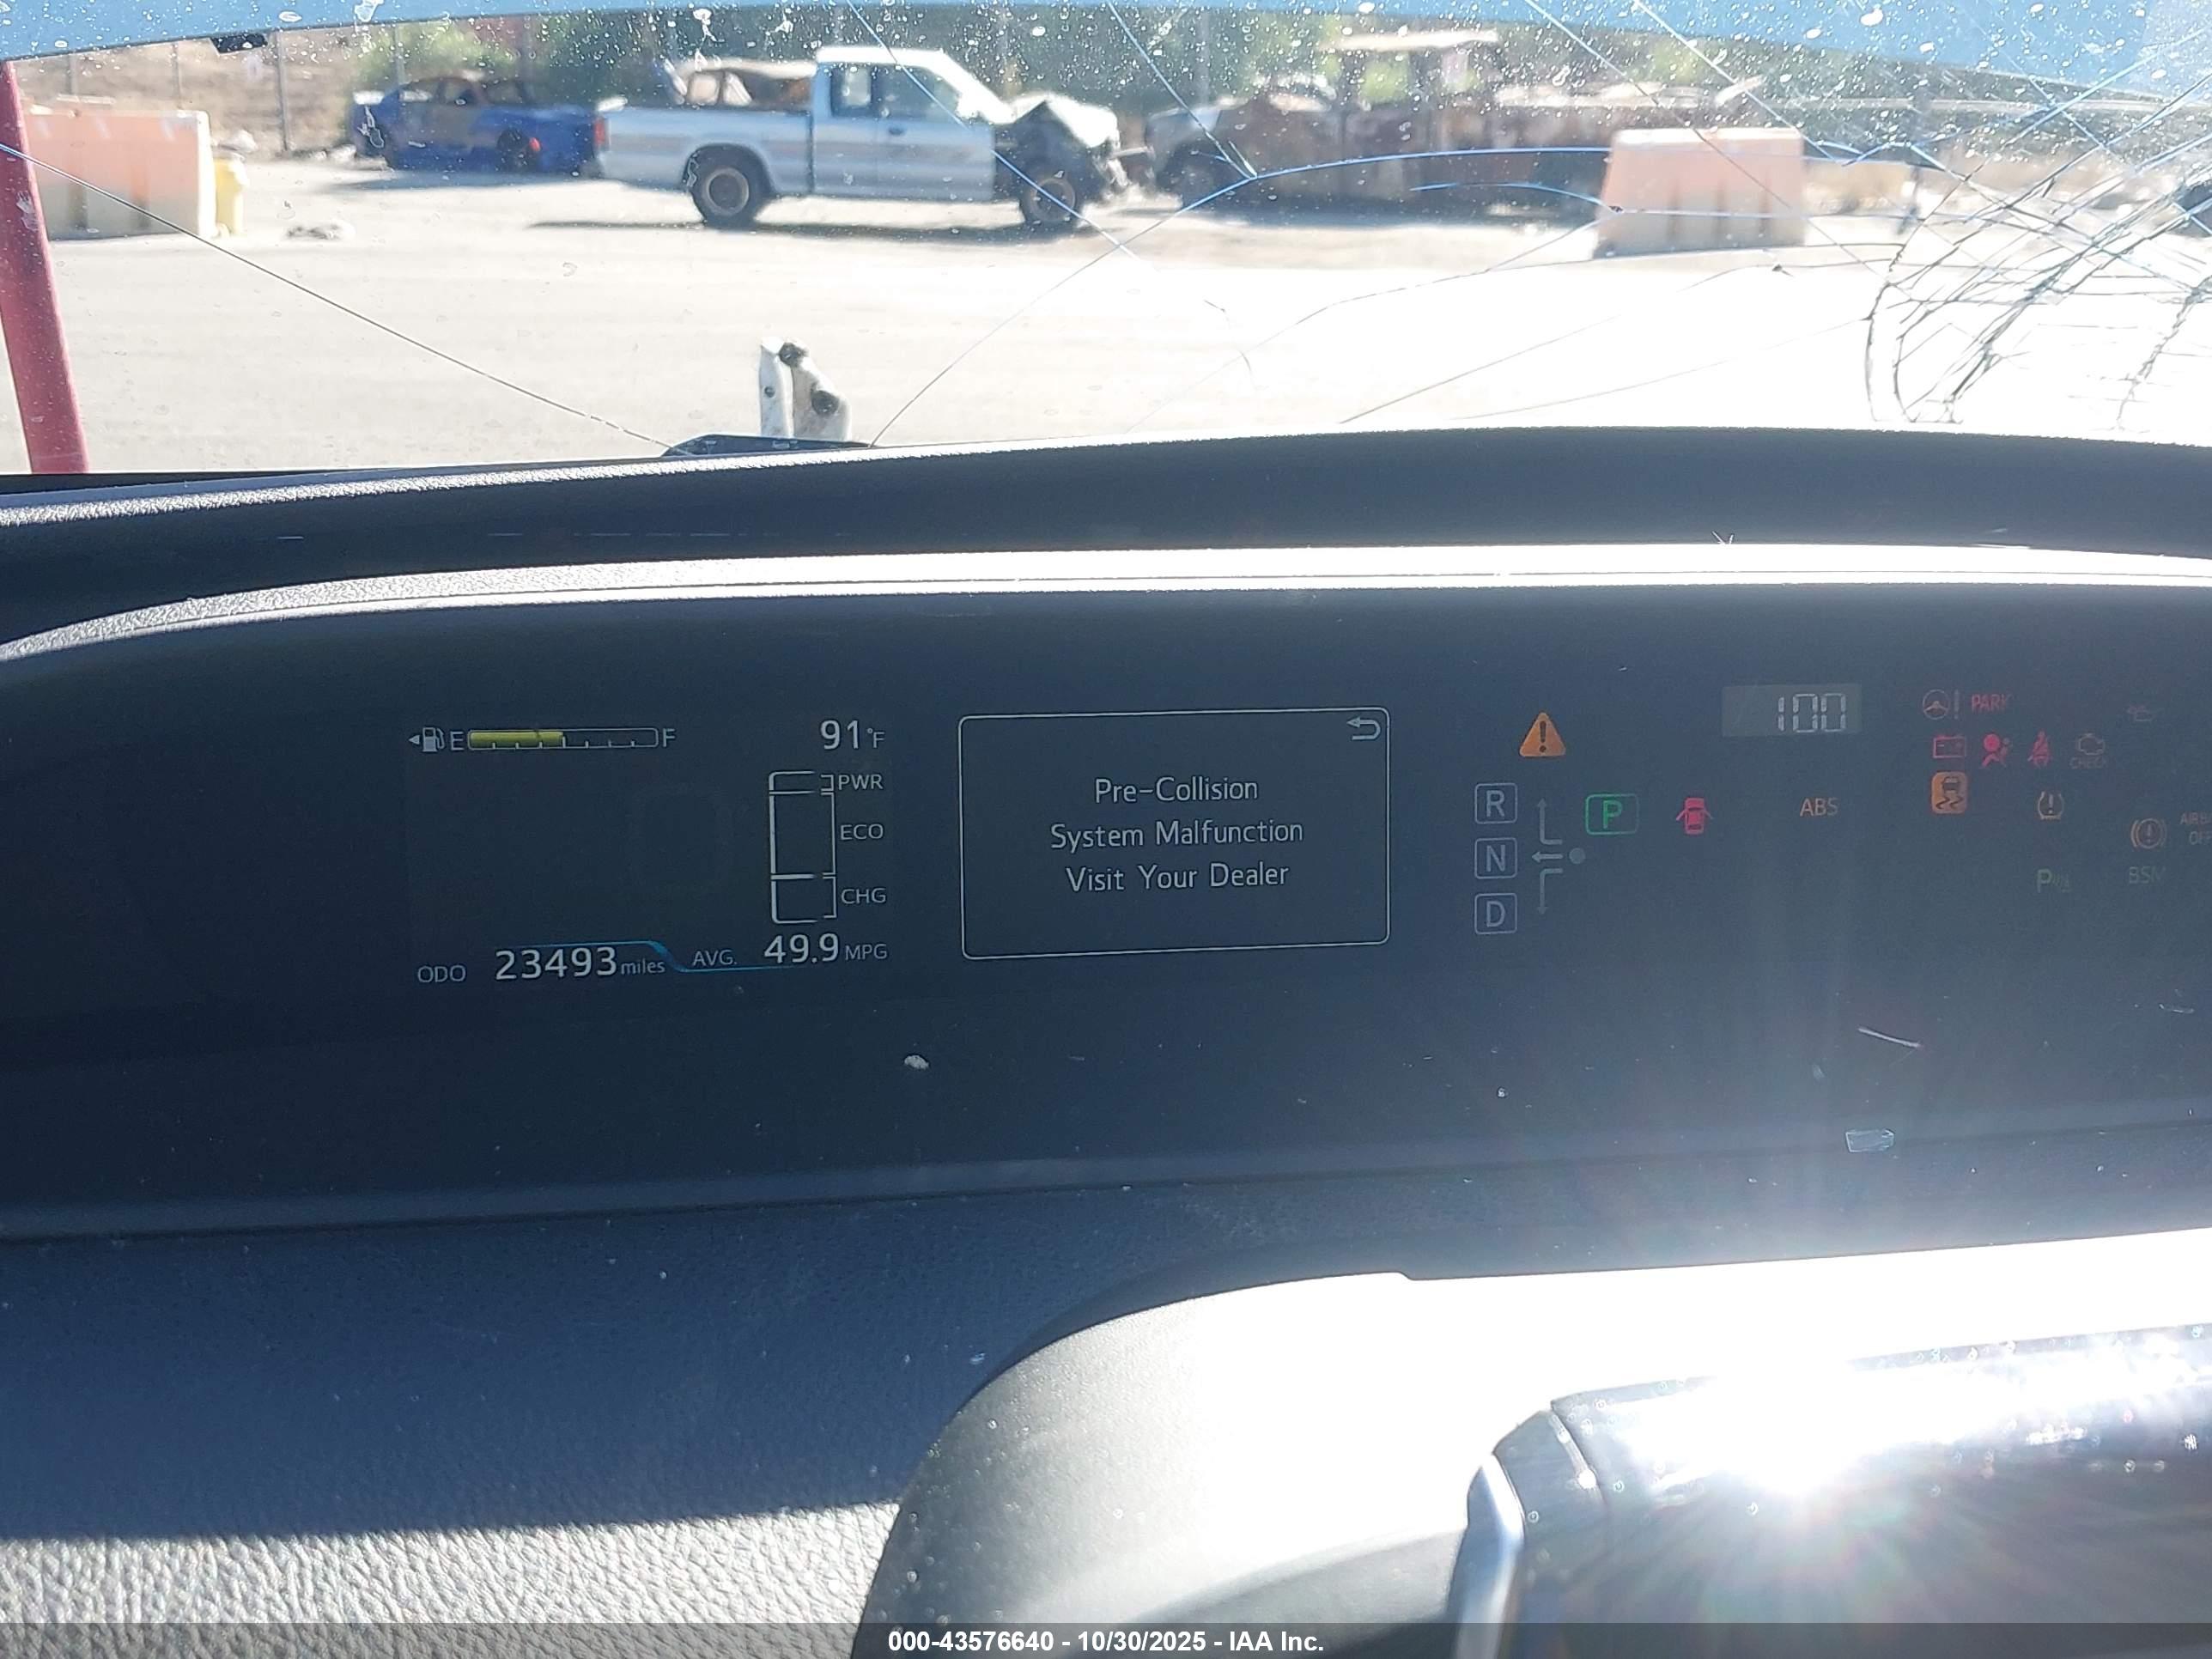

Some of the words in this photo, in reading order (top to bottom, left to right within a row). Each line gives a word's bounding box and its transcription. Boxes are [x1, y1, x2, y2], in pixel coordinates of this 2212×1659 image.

[837, 774, 884, 790] PWR
[1095, 775, 1259, 804] Pre-Collision
[1486, 790, 1505, 817] R
[1602, 799, 1623, 830] P
[1799, 798, 1839, 817] ABS
[840, 823, 884, 841] ECO
[1050, 823, 1144, 854] System
[1156, 819, 1304, 846] Malfunction
[1486, 846, 1506, 872] N
[1066, 866, 1125, 891] Visit
[1138, 864, 1198, 890] Your
[1210, 861, 1289, 887] Dealer
[841, 888, 887, 904] CHG
[1486, 901, 1506, 927] D
[692, 949, 738, 967] AVG.
[764, 933, 840, 963] 49.9
[845, 945, 888, 961] MPG
[417, 965, 467, 983] ODO
[495, 946, 617, 981] 23493
[620, 958, 666, 975] miles
